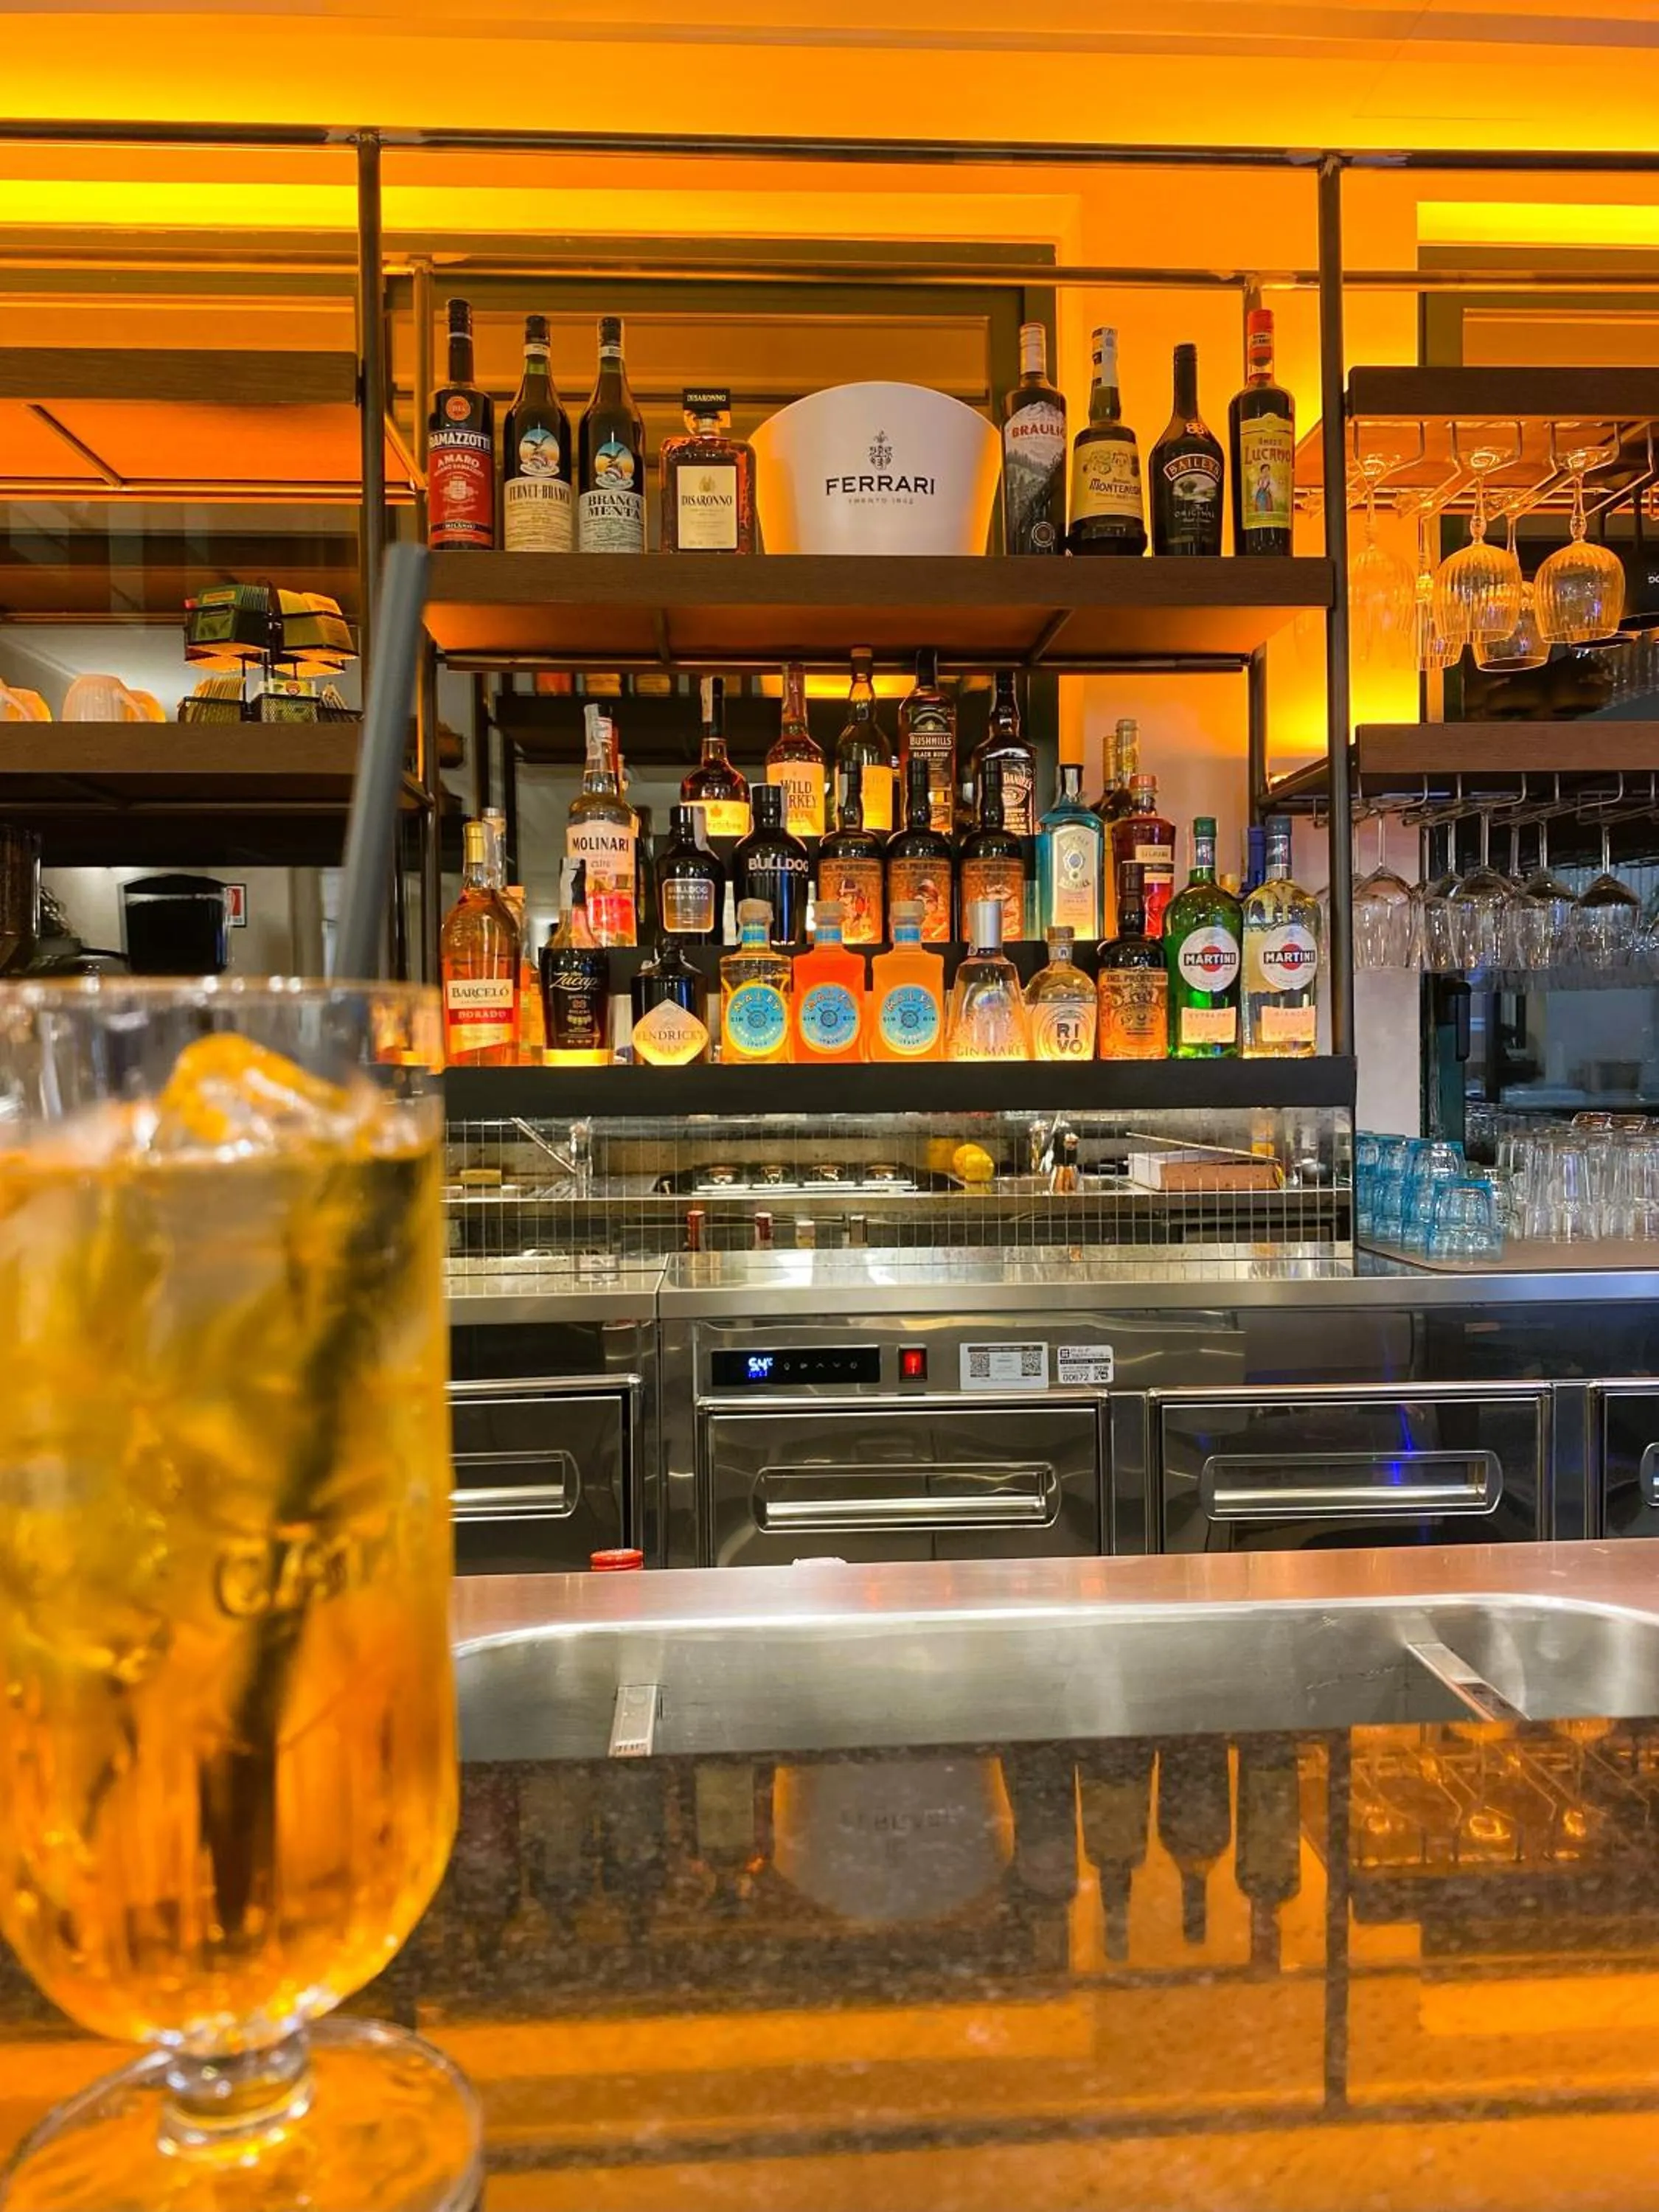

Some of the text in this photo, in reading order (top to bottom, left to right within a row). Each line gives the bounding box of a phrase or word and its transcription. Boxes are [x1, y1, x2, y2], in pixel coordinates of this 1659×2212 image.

[687, 394, 726, 402] DISARONNO
[438, 453, 480, 469] AMARO
[826, 475, 935, 495] FERRARI
[589, 495, 640, 509] BRANCA
[681, 495, 732, 507] DISARONNO
[589, 506, 640, 518] MENTA
[909, 736, 953, 746] BUSHMILLS
[788, 794, 817, 810] RKEY
[572, 837, 630, 852] MOLINARI
[748, 857, 809, 872] BULLDOG
[1186, 954, 1235, 965] MARTINI
[1265, 952, 1314, 963] MARTINI
[957, 1046, 980, 1056] GIN
